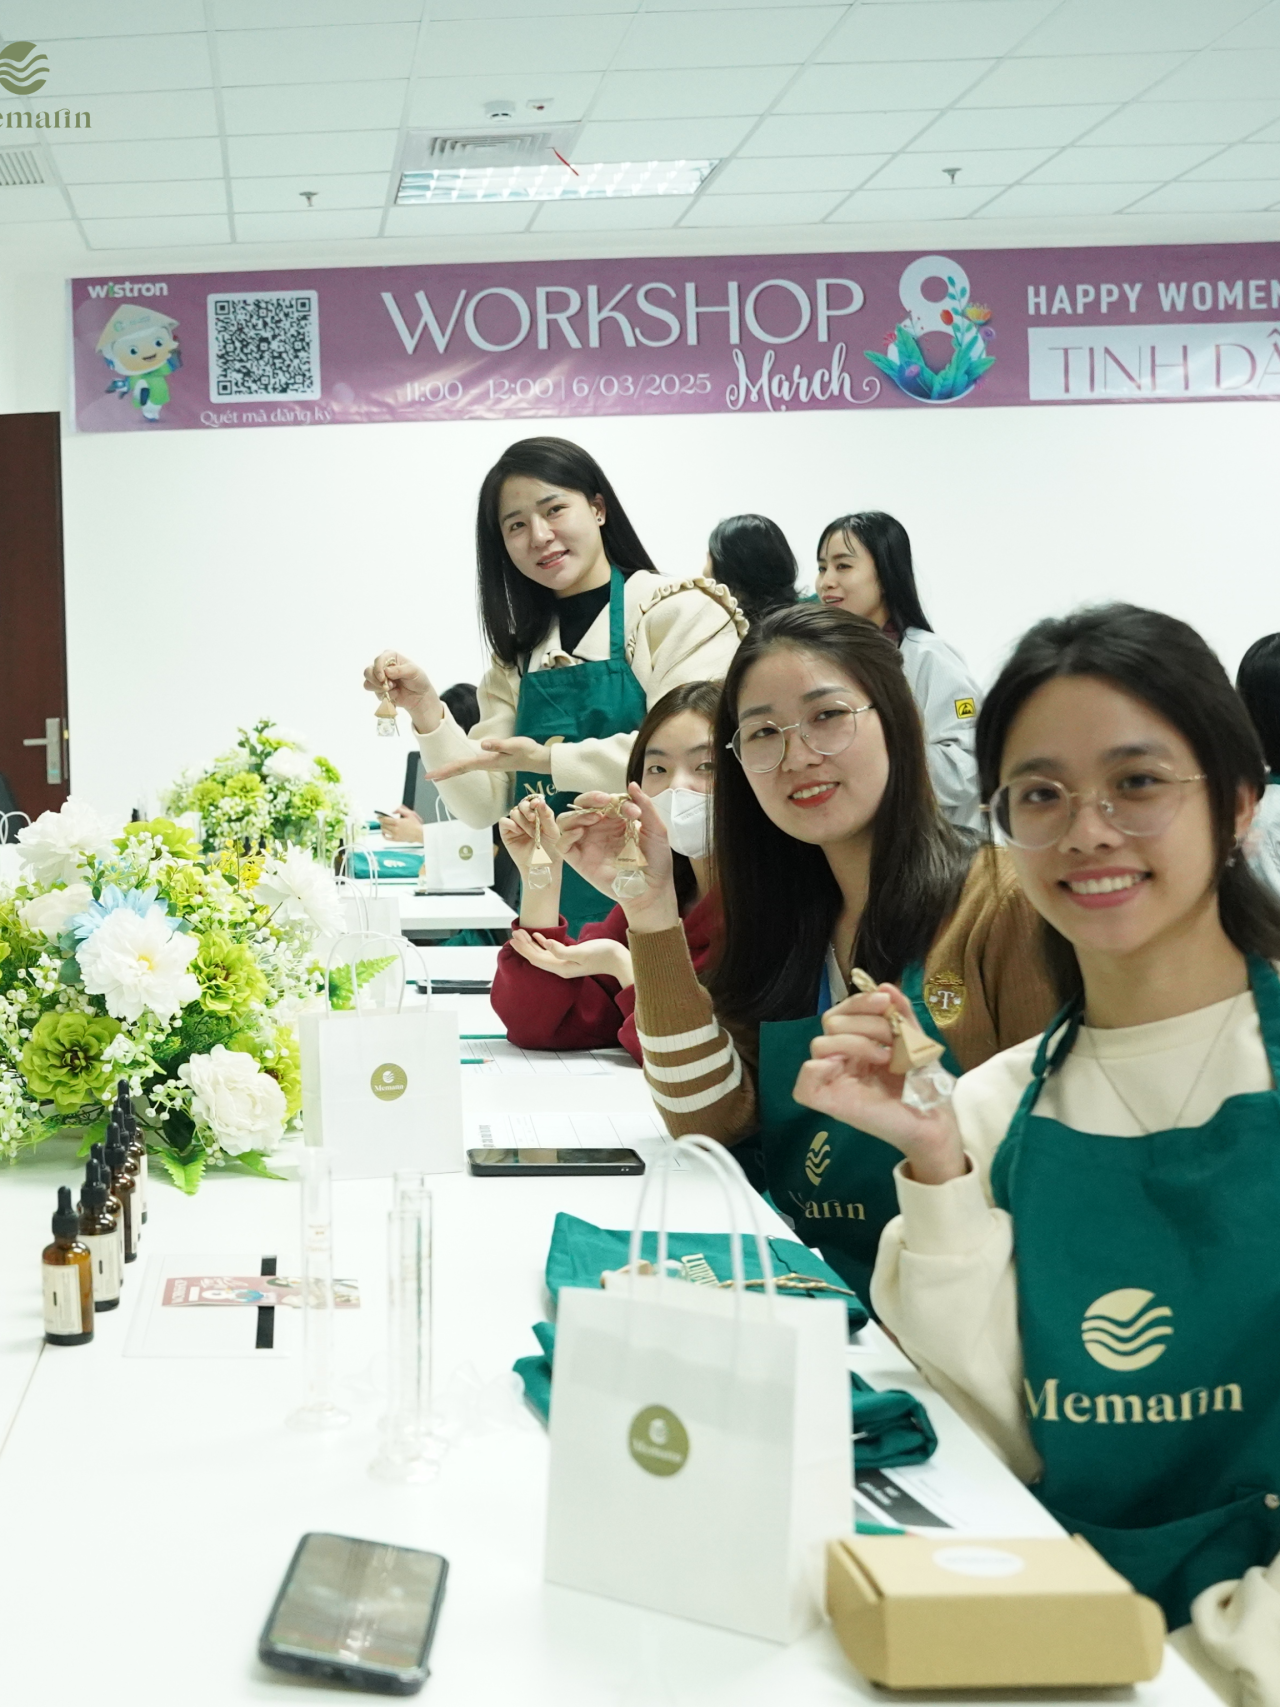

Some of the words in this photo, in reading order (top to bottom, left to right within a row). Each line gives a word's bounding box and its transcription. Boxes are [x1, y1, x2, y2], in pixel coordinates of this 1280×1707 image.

[88, 281, 168, 299] wistron
[1027, 282, 1143, 315] HAPPY
[380, 277, 866, 355] WORKSHOP
[489, 377, 554, 400] 12:00
[572, 372, 712, 400] 6/03/2025
[725, 341, 881, 412] March
[1048, 345, 1189, 394] TINH
